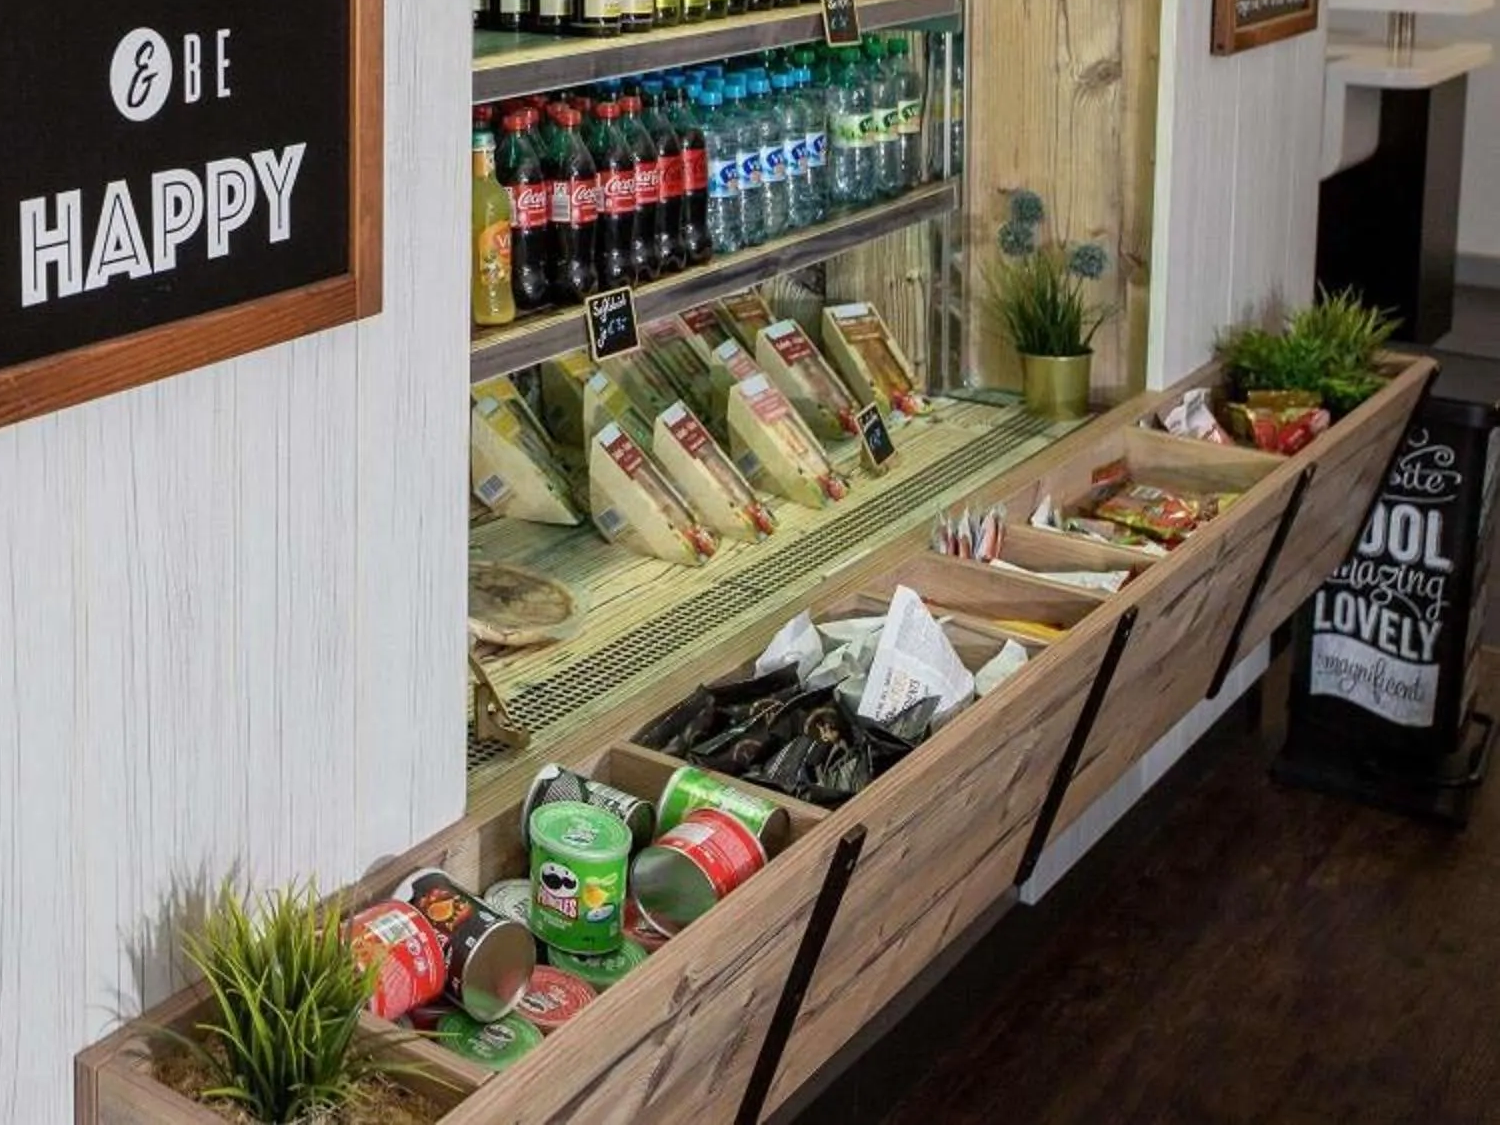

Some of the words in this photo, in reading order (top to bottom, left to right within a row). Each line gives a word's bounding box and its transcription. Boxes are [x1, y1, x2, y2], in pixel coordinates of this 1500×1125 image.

[183, 27, 232, 104] BE
[20, 141, 307, 308] HAPPY
[1313, 589, 1443, 662] LOVELY
